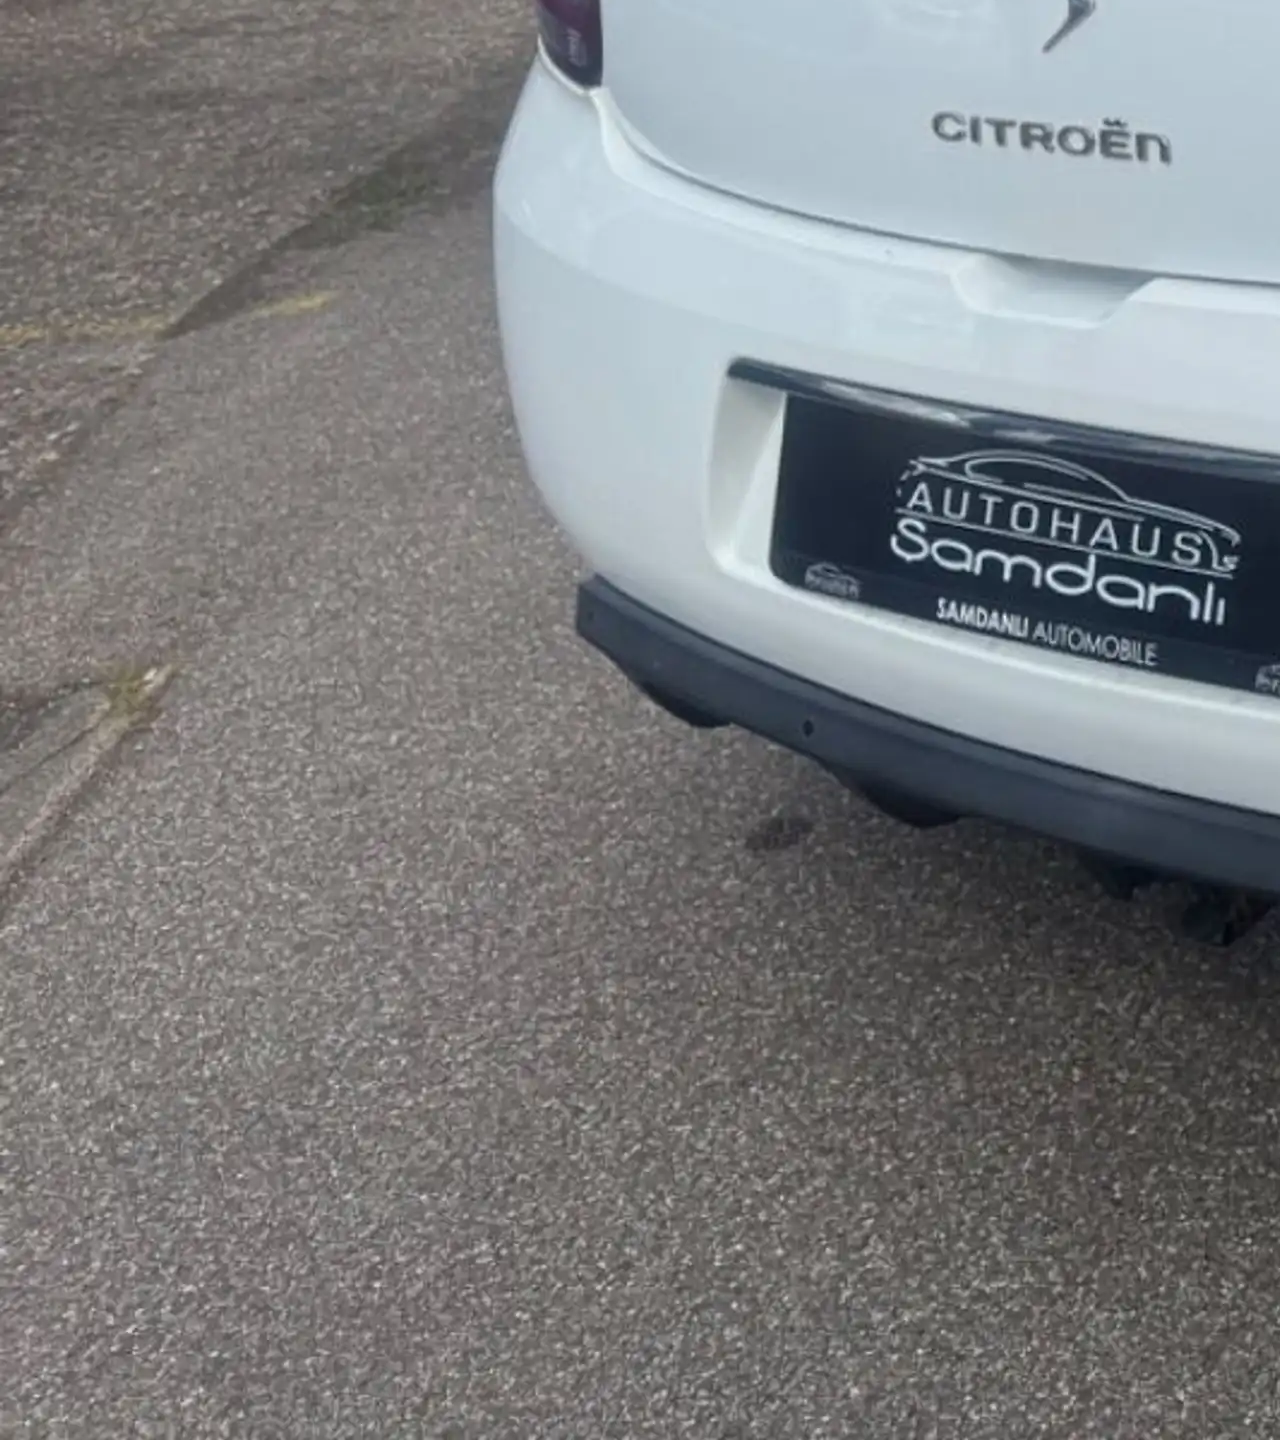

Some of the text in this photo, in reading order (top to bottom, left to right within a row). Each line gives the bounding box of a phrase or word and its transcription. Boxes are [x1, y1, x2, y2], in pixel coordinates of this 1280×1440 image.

[907, 482, 1203, 566] AUTOHAUS
[936, 596, 1159, 666] SAMDANLI AUTOMOBILE
